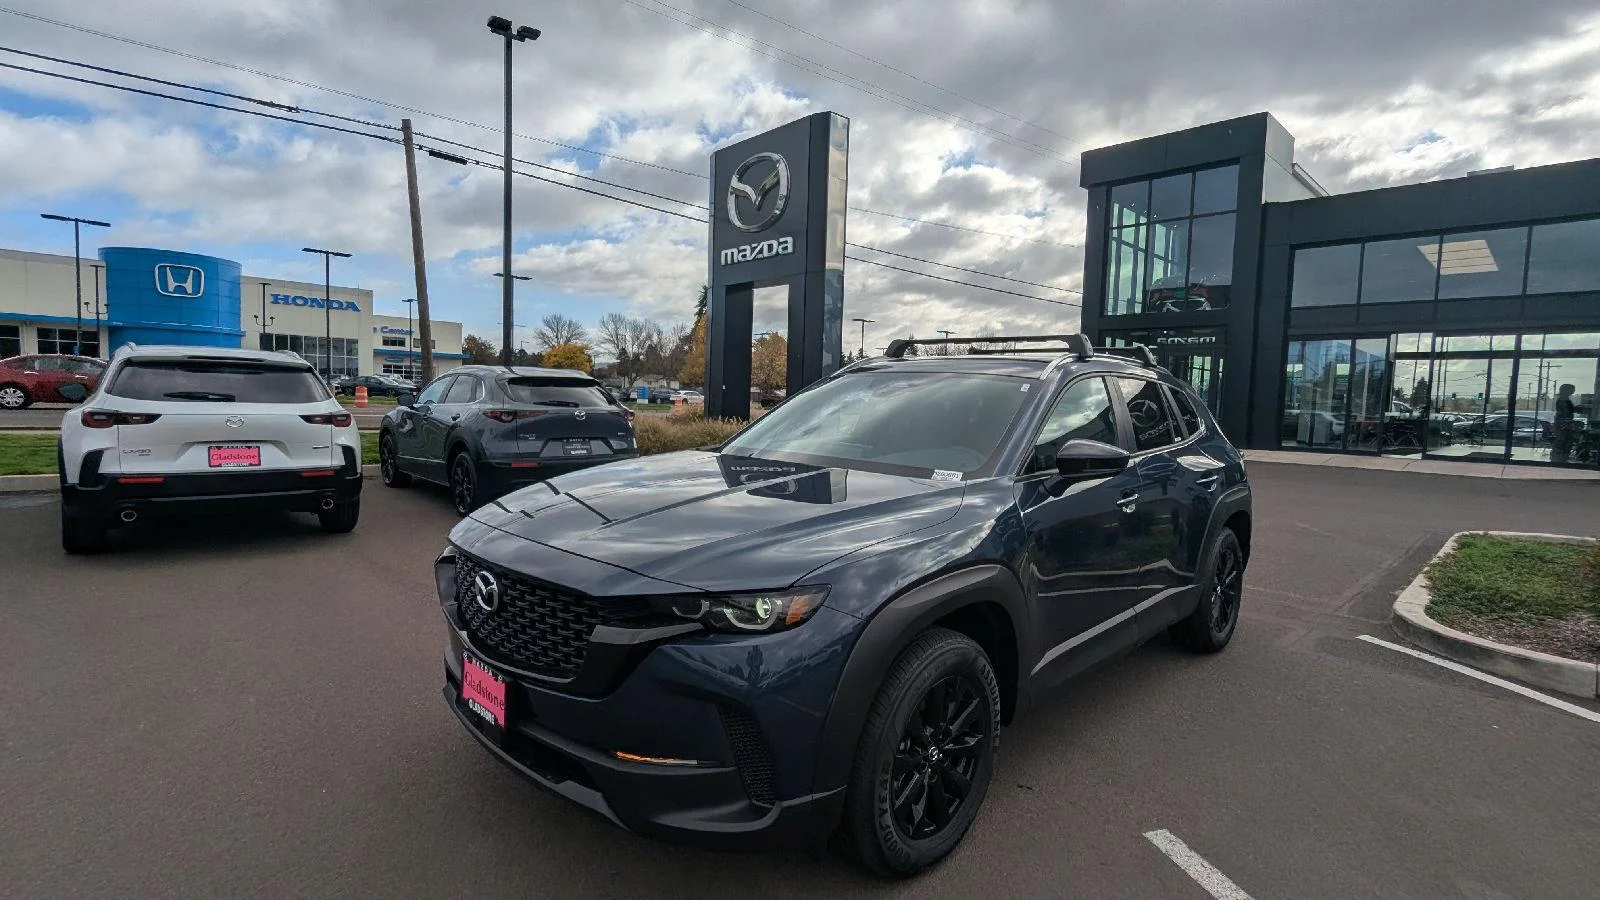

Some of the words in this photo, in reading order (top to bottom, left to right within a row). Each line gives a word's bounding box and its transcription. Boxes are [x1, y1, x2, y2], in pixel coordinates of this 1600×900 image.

[720, 236, 794, 266] mazda
[270, 293, 361, 312] HONDA
[211, 453, 258, 461] Gladstone
[464, 671, 505, 711] Gladstone
